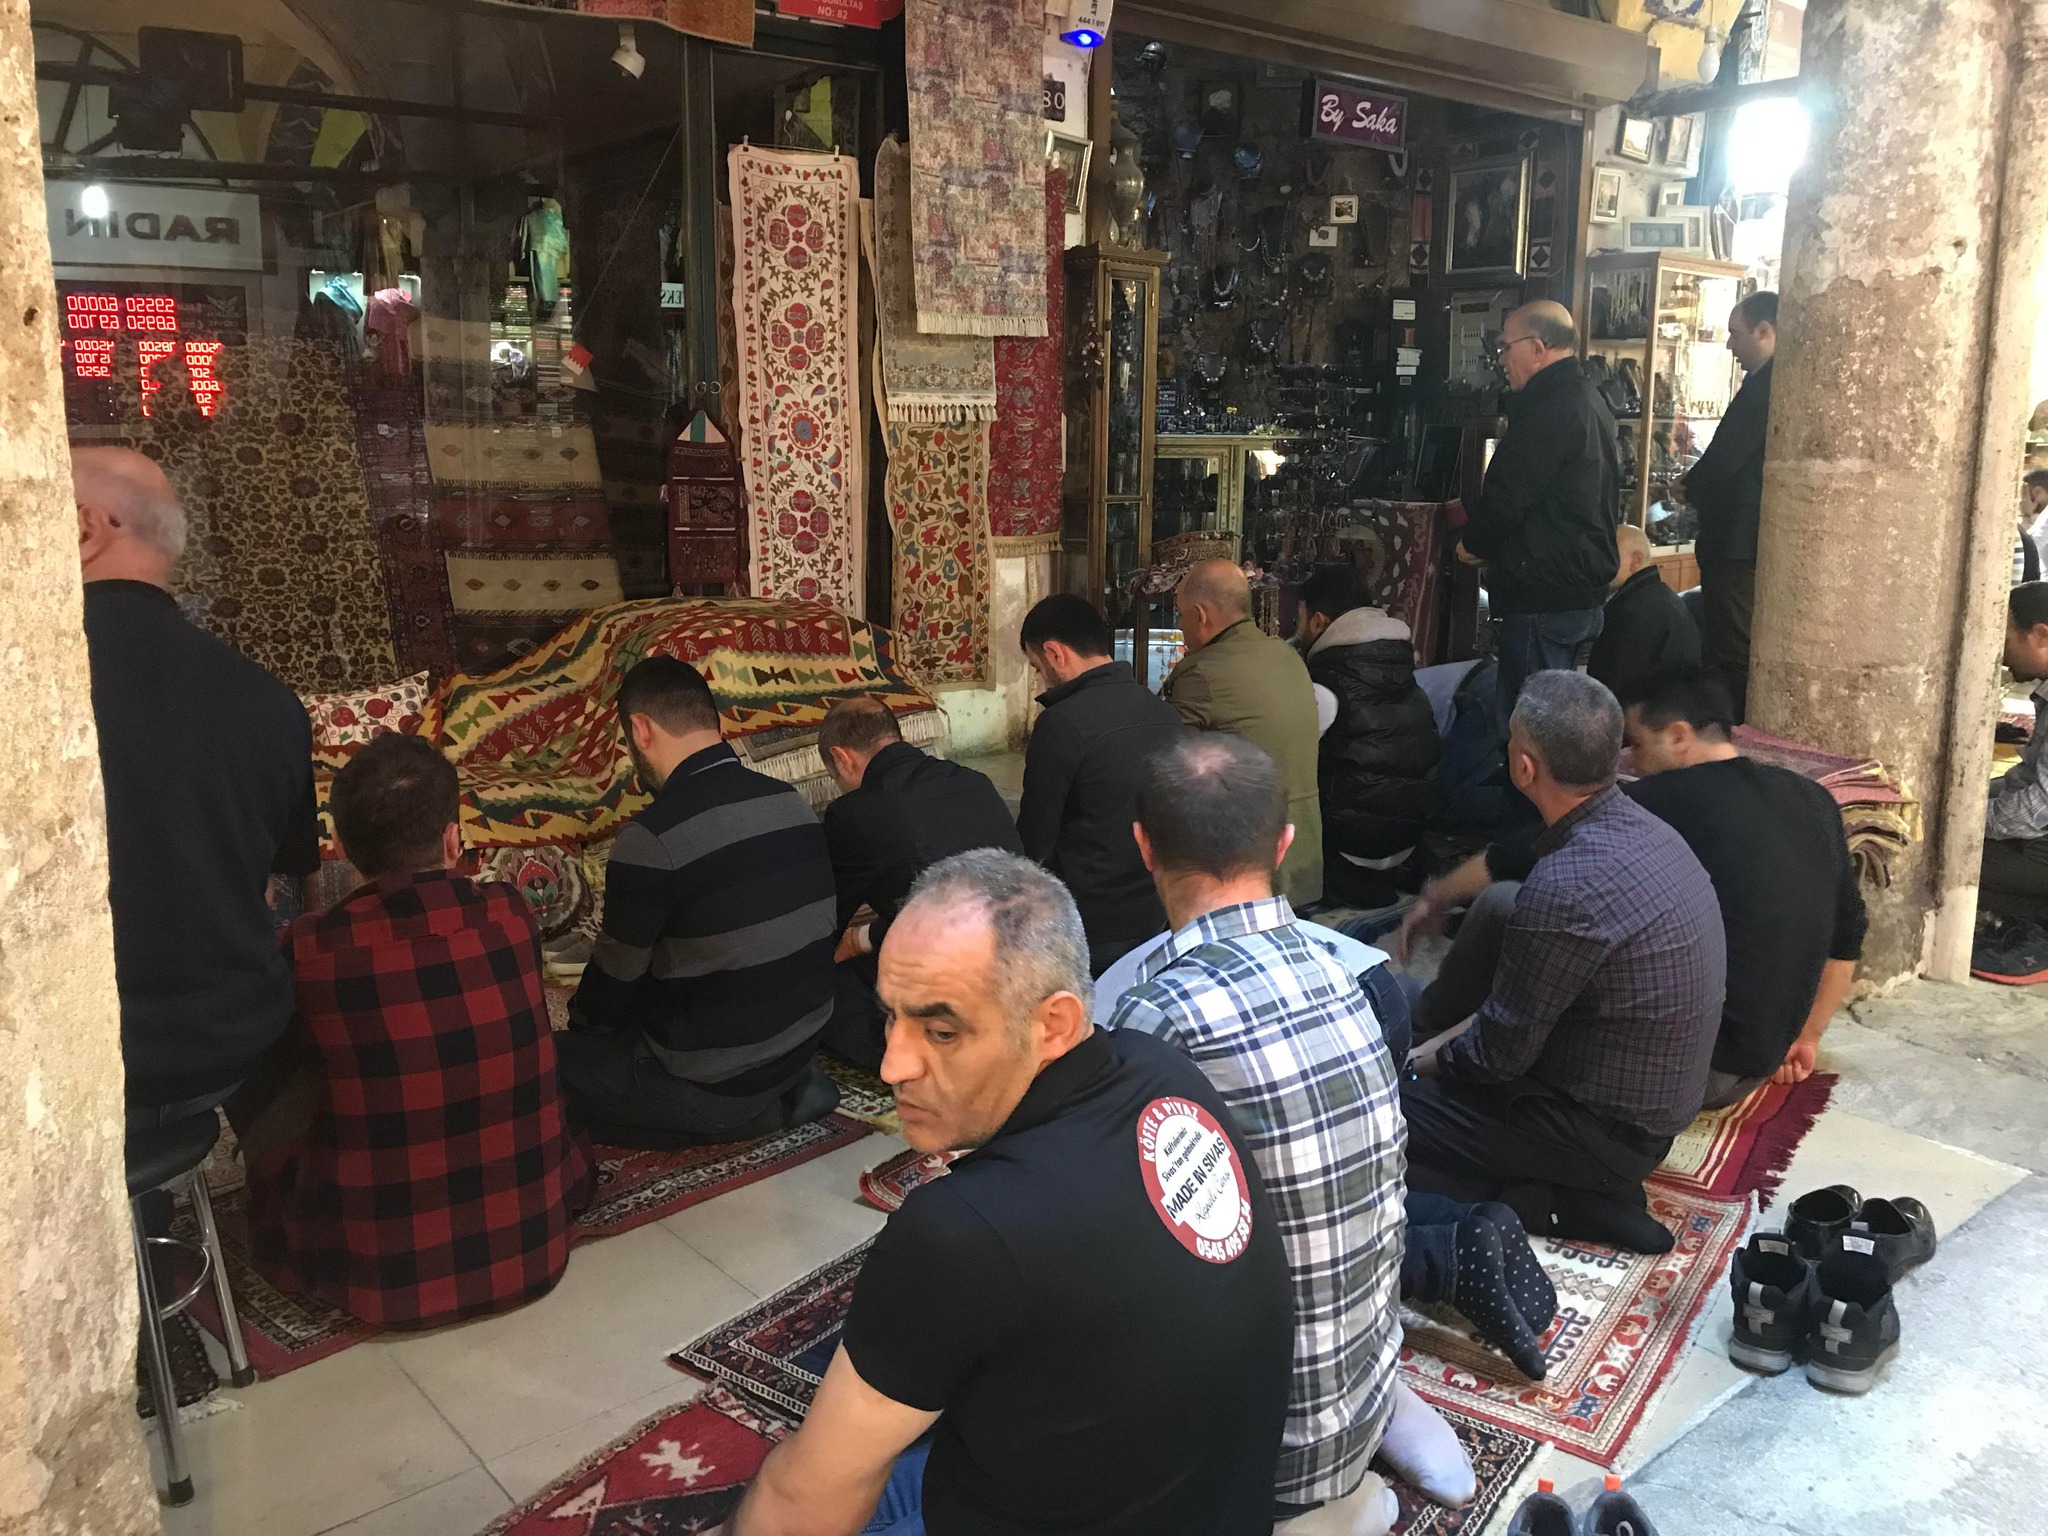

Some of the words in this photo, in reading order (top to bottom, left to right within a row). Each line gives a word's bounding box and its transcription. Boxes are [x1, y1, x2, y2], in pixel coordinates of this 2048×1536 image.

[817, 5, 834, 17] NO:
[837, 9, 848, 20] 82
[1043, 90, 1065, 110] 80
[1321, 94, 1344, 132] By
[1352, 101, 1398, 134] Saka
[1139, 1116, 1158, 1162] KÖFTE
[1152, 1107, 1166, 1120] &
[1166, 1178, 1198, 1219] MADE
[1192, 1165, 1208, 1186] IN
[1196, 1236, 1226, 1260] 0545
[1225, 1231, 1243, 1257] 495
